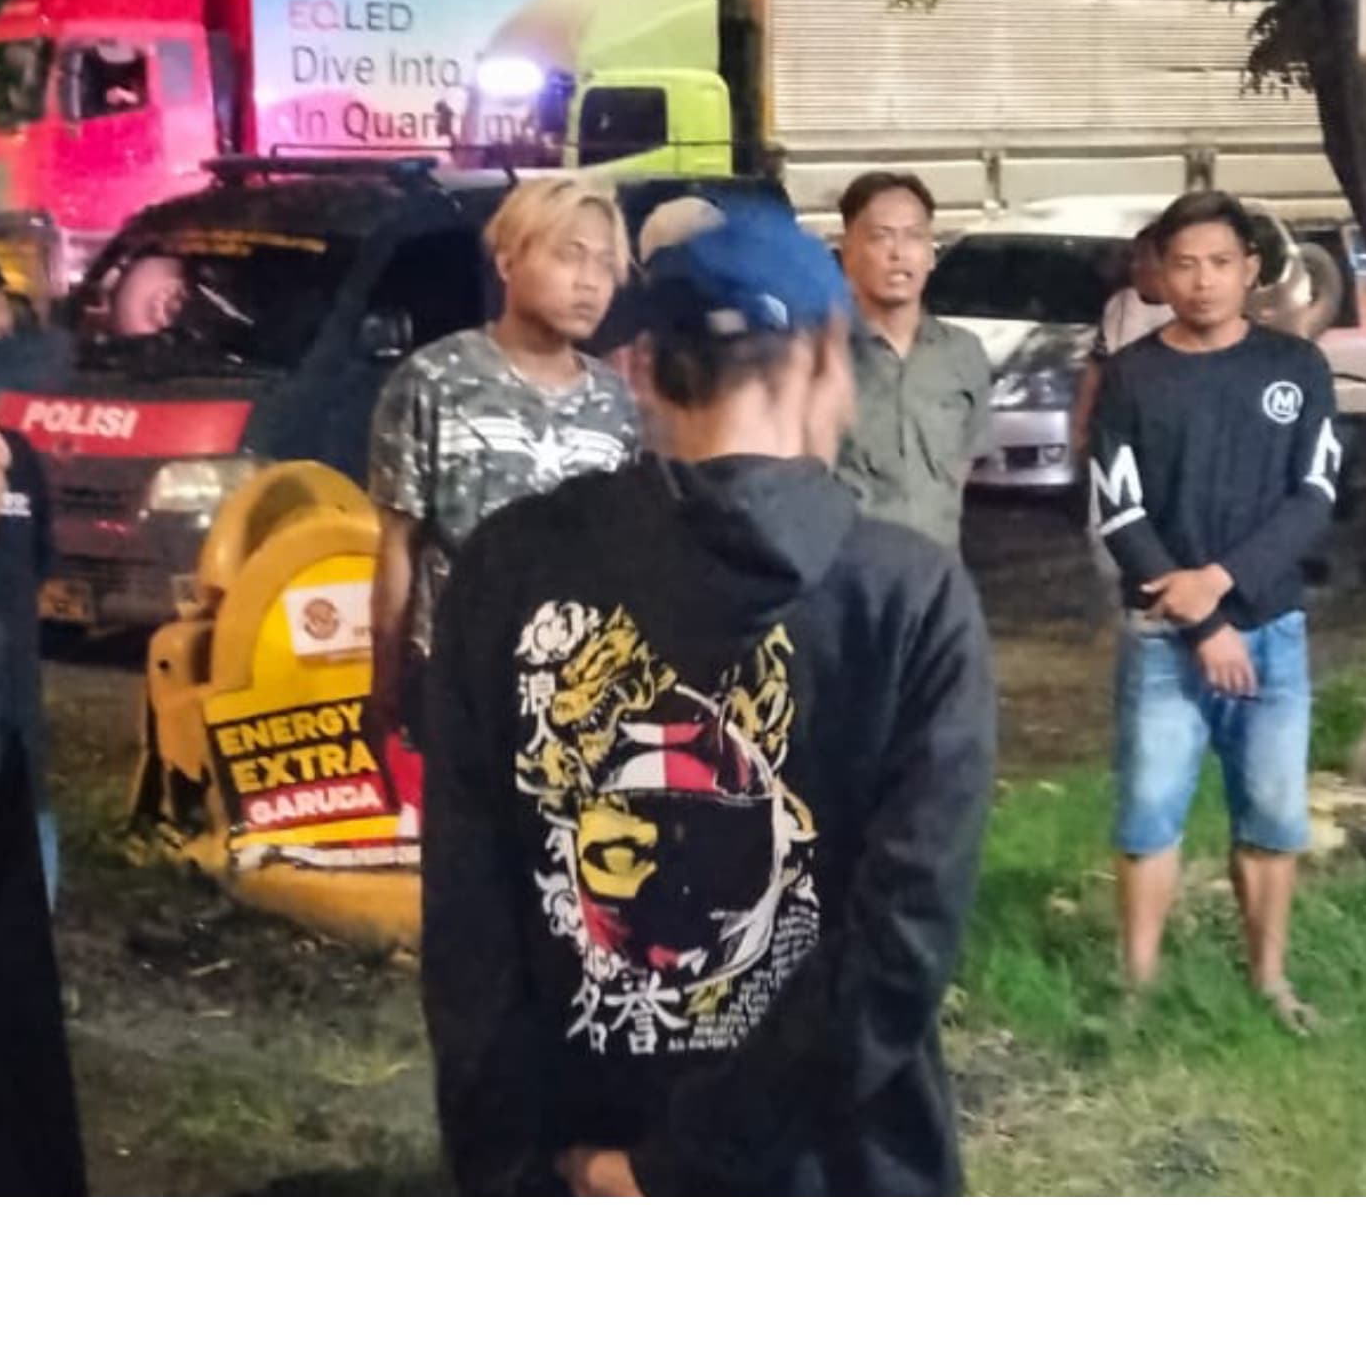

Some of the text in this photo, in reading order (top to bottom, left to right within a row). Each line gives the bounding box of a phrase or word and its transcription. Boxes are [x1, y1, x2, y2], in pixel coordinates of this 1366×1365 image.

[292, 45, 462, 87] Dive Into
[294, 102, 326, 136] In
[22, 399, 138, 439] POLISI
[216, 702, 363, 757] ENERGY
[231, 741, 378, 794] EXTRA
[248, 781, 383, 826] GARUDA
